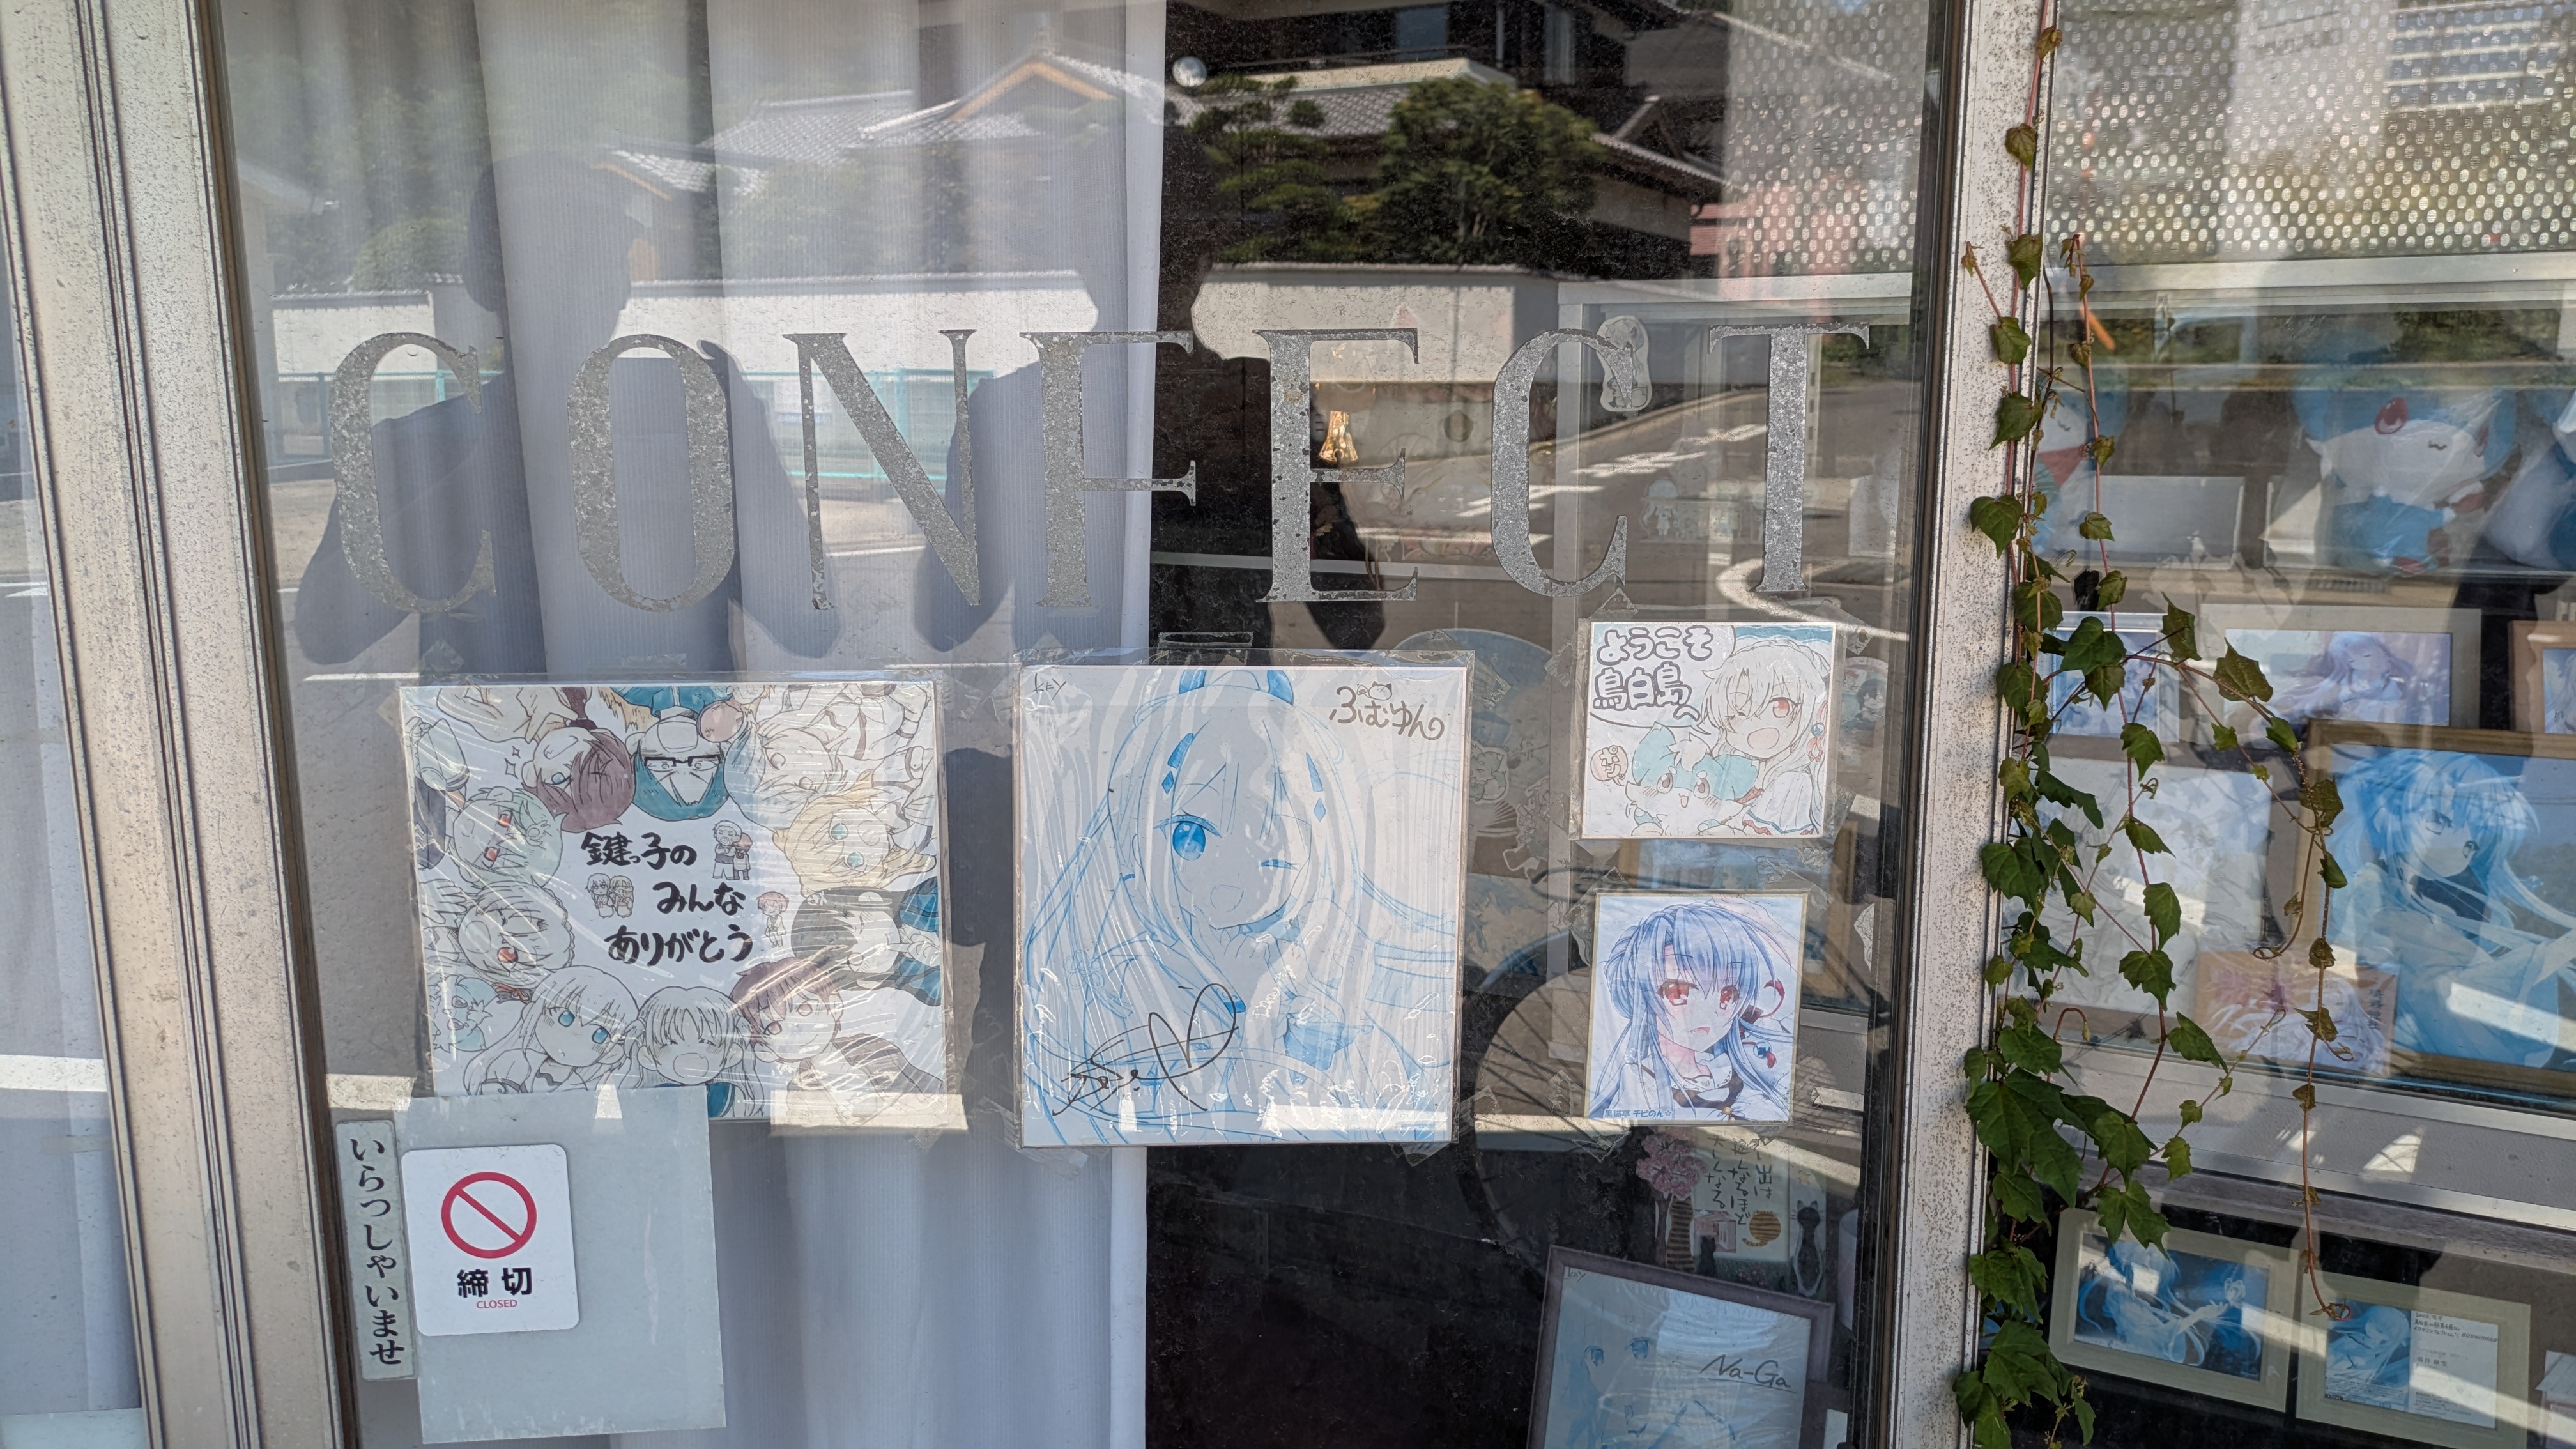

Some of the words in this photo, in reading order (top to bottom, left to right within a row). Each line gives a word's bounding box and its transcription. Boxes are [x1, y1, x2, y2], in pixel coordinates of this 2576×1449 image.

[328, 323, 1871, 615] CONFECT
[1595, 625, 1713, 665] ようこそ
[581, 832, 697, 869] 鍵っ子の
[652, 882, 745, 916] みんな
[605, 924, 753, 966] ありがとう
[456, 1267, 533, 1298] 締切
[476, 1299, 518, 1309] CLOSED
[2461, 1333, 2497, 1342] BUSHIROAD
[1699, 1354, 1791, 1389] Na-Ga
